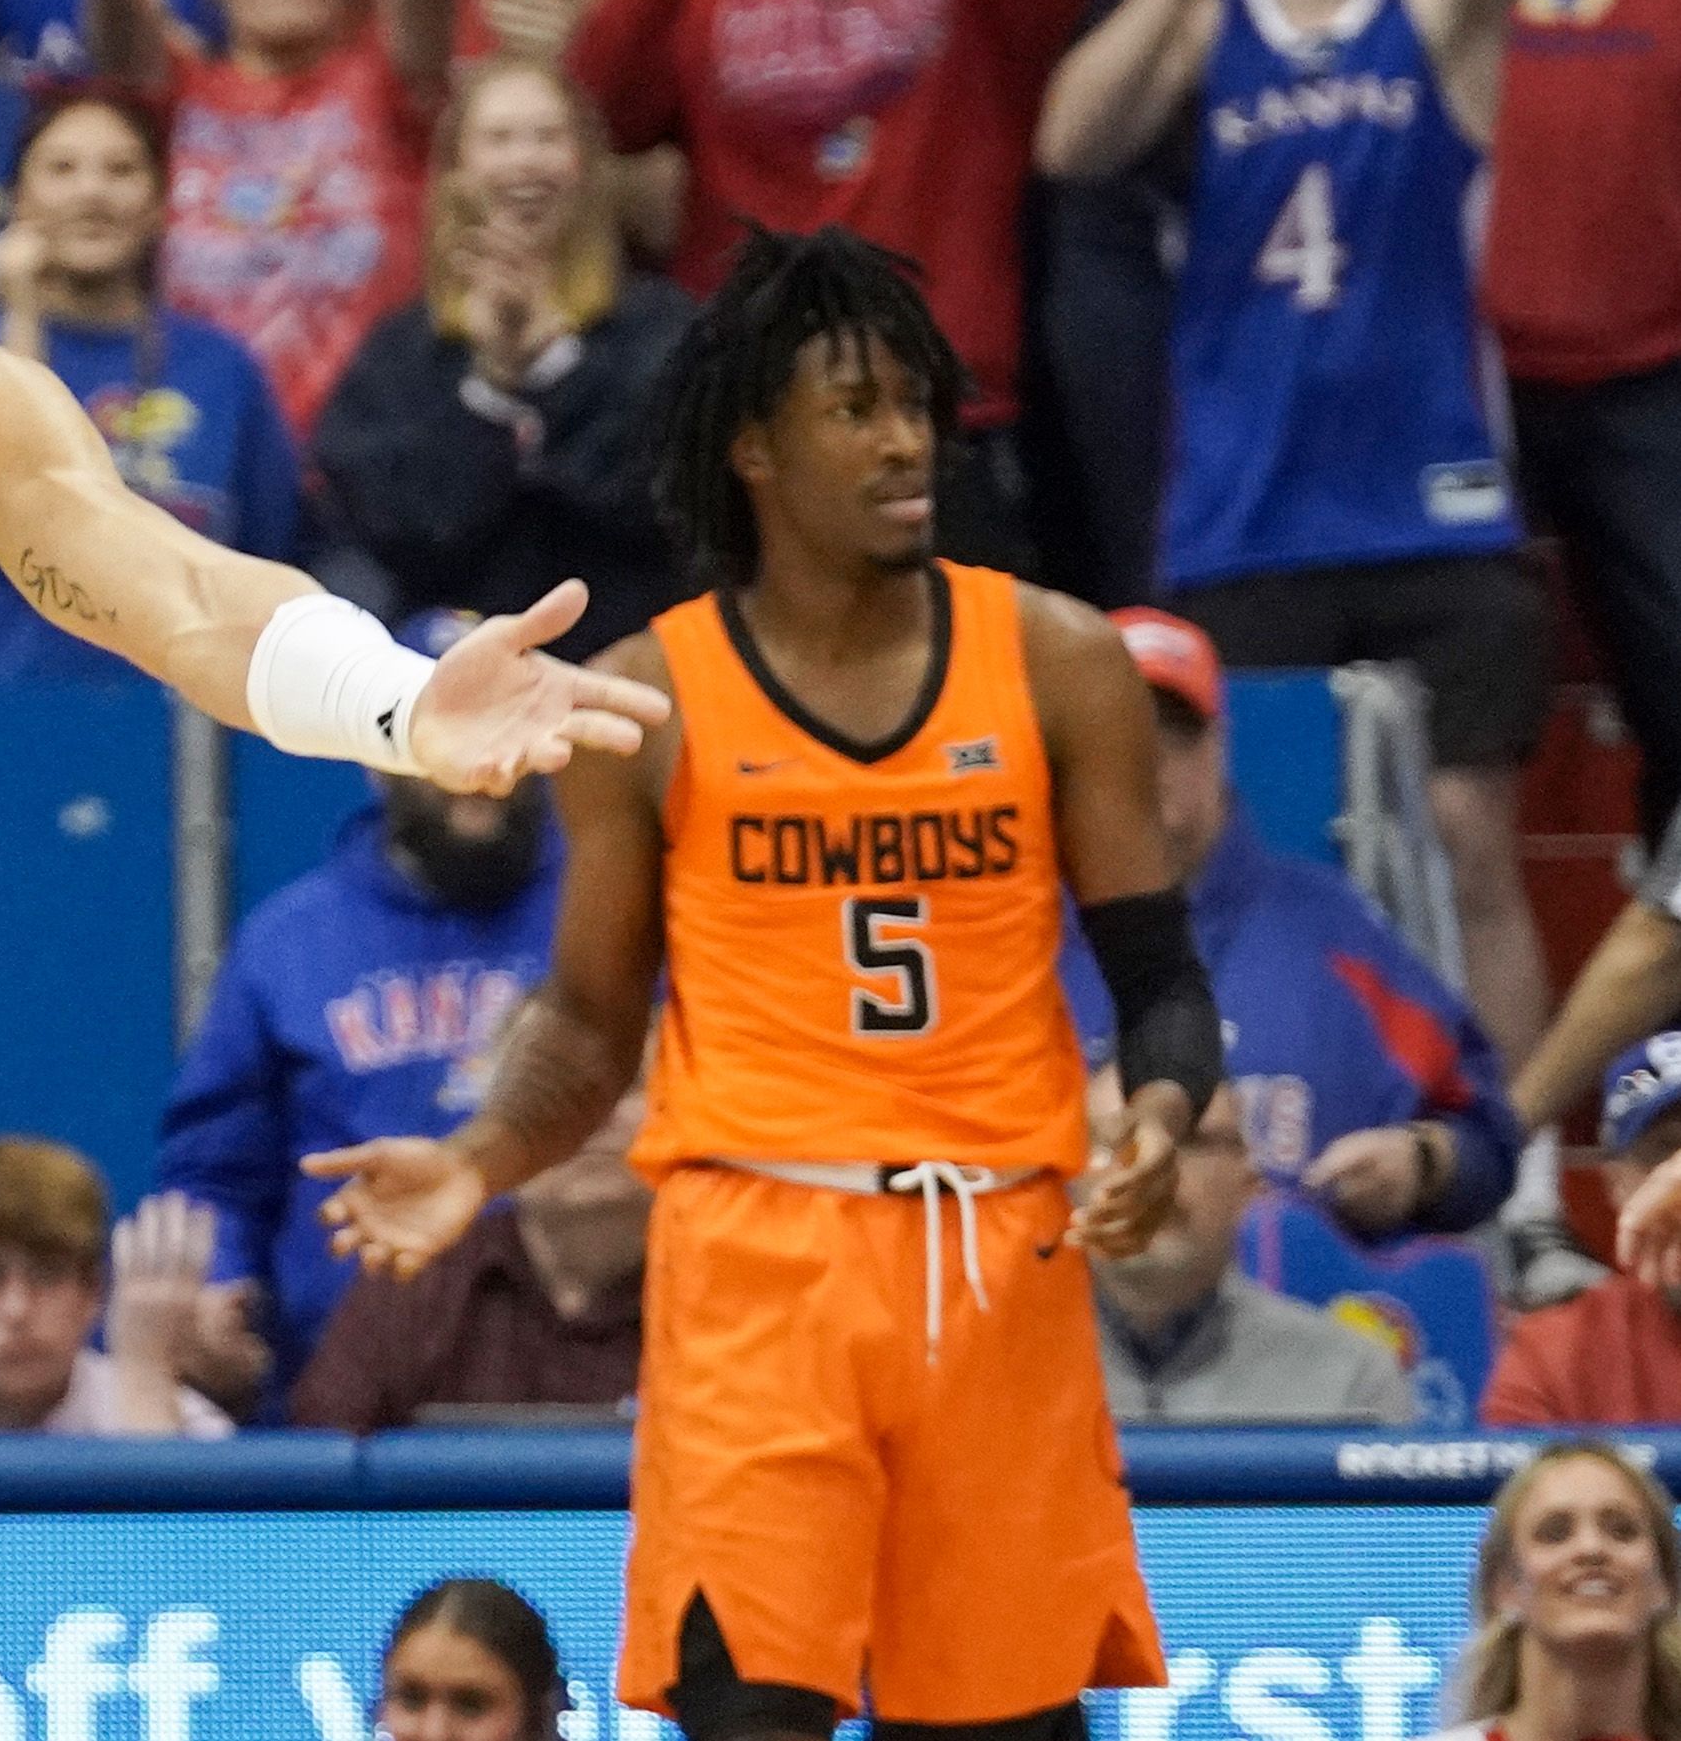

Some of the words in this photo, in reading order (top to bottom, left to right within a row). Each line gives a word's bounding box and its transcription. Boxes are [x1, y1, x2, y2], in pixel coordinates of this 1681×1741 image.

[1254, 161, 1351, 308] 4
[730, 802, 1020, 887] COWBOYS
[842, 895, 939, 1038] 5
[1115, 1616, 1440, 1741] rst
